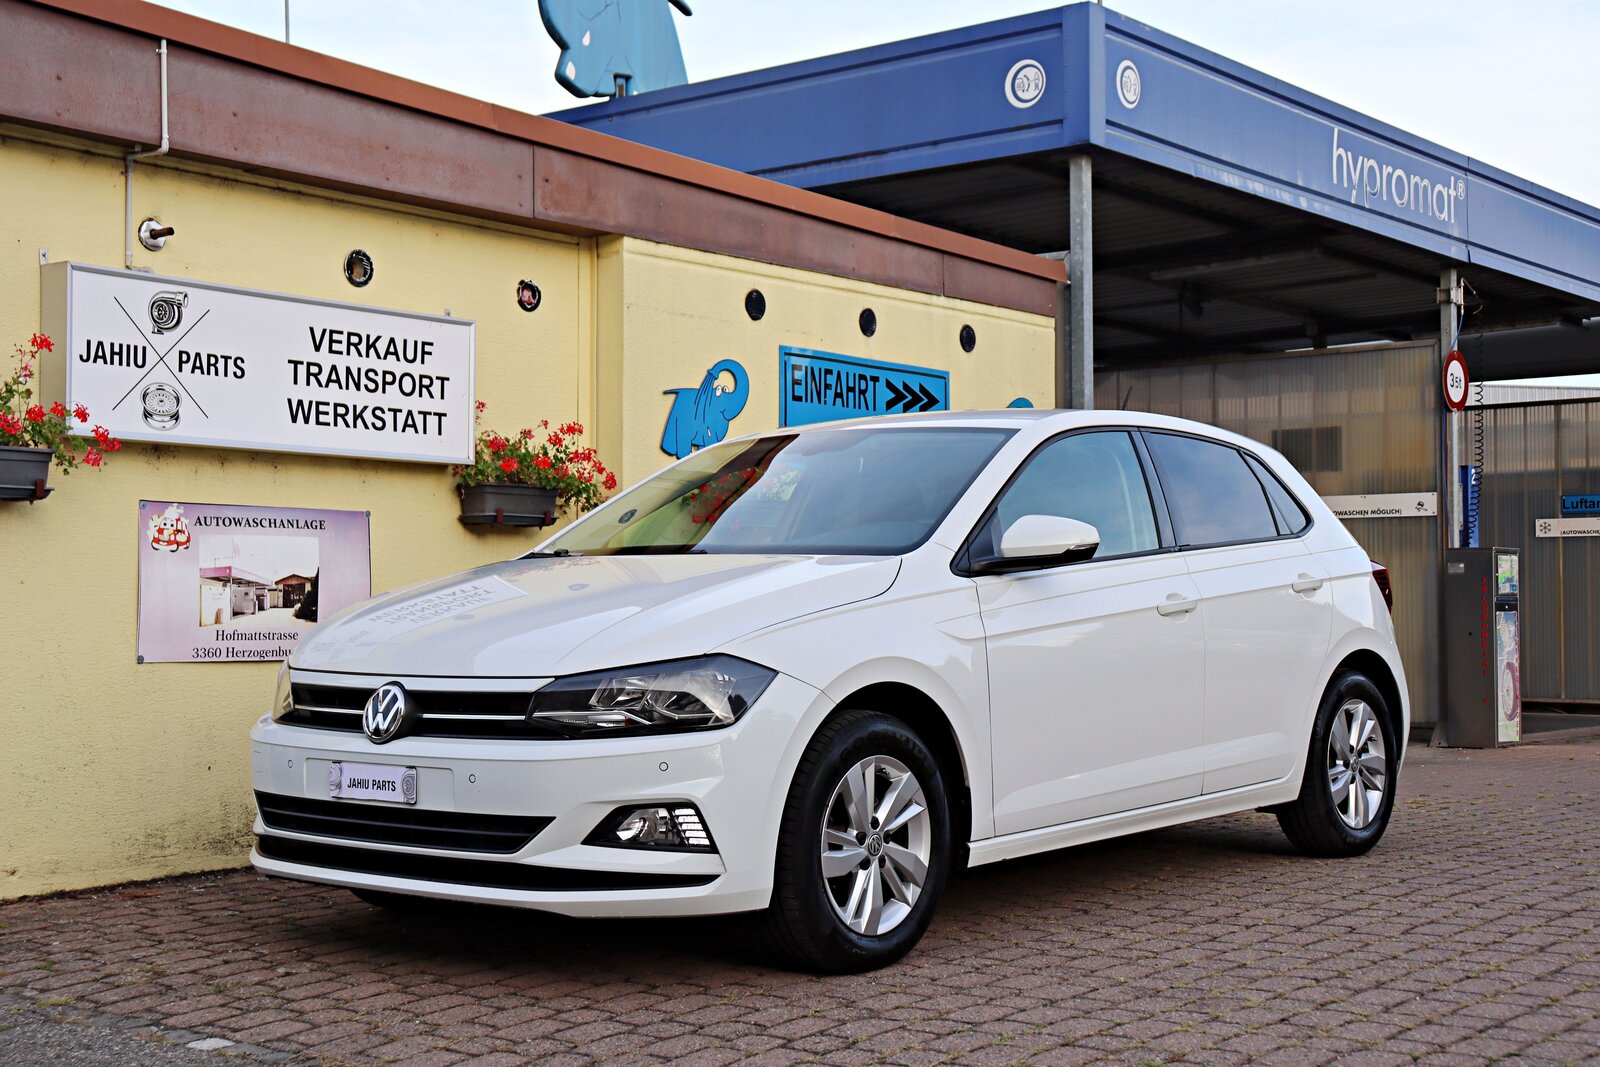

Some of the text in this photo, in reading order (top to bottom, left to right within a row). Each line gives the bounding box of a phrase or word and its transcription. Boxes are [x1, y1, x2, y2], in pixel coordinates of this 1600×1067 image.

[79, 339, 246, 380] JAHIU PARTS
[309, 326, 434, 365] VERKAUF
[287, 359, 450, 400] TRANSPORT
[791, 363, 880, 412] EINFAHRT
[287, 398, 447, 436] WERKSTATT
[194, 516, 326, 530] AUTOWASCHANLAGE
[192, 646, 293, 659] 3360 Herzogenbu
[215, 629, 299, 641] Hofmattstrasse
[347, 777, 396, 792] JAHIU PARTS
